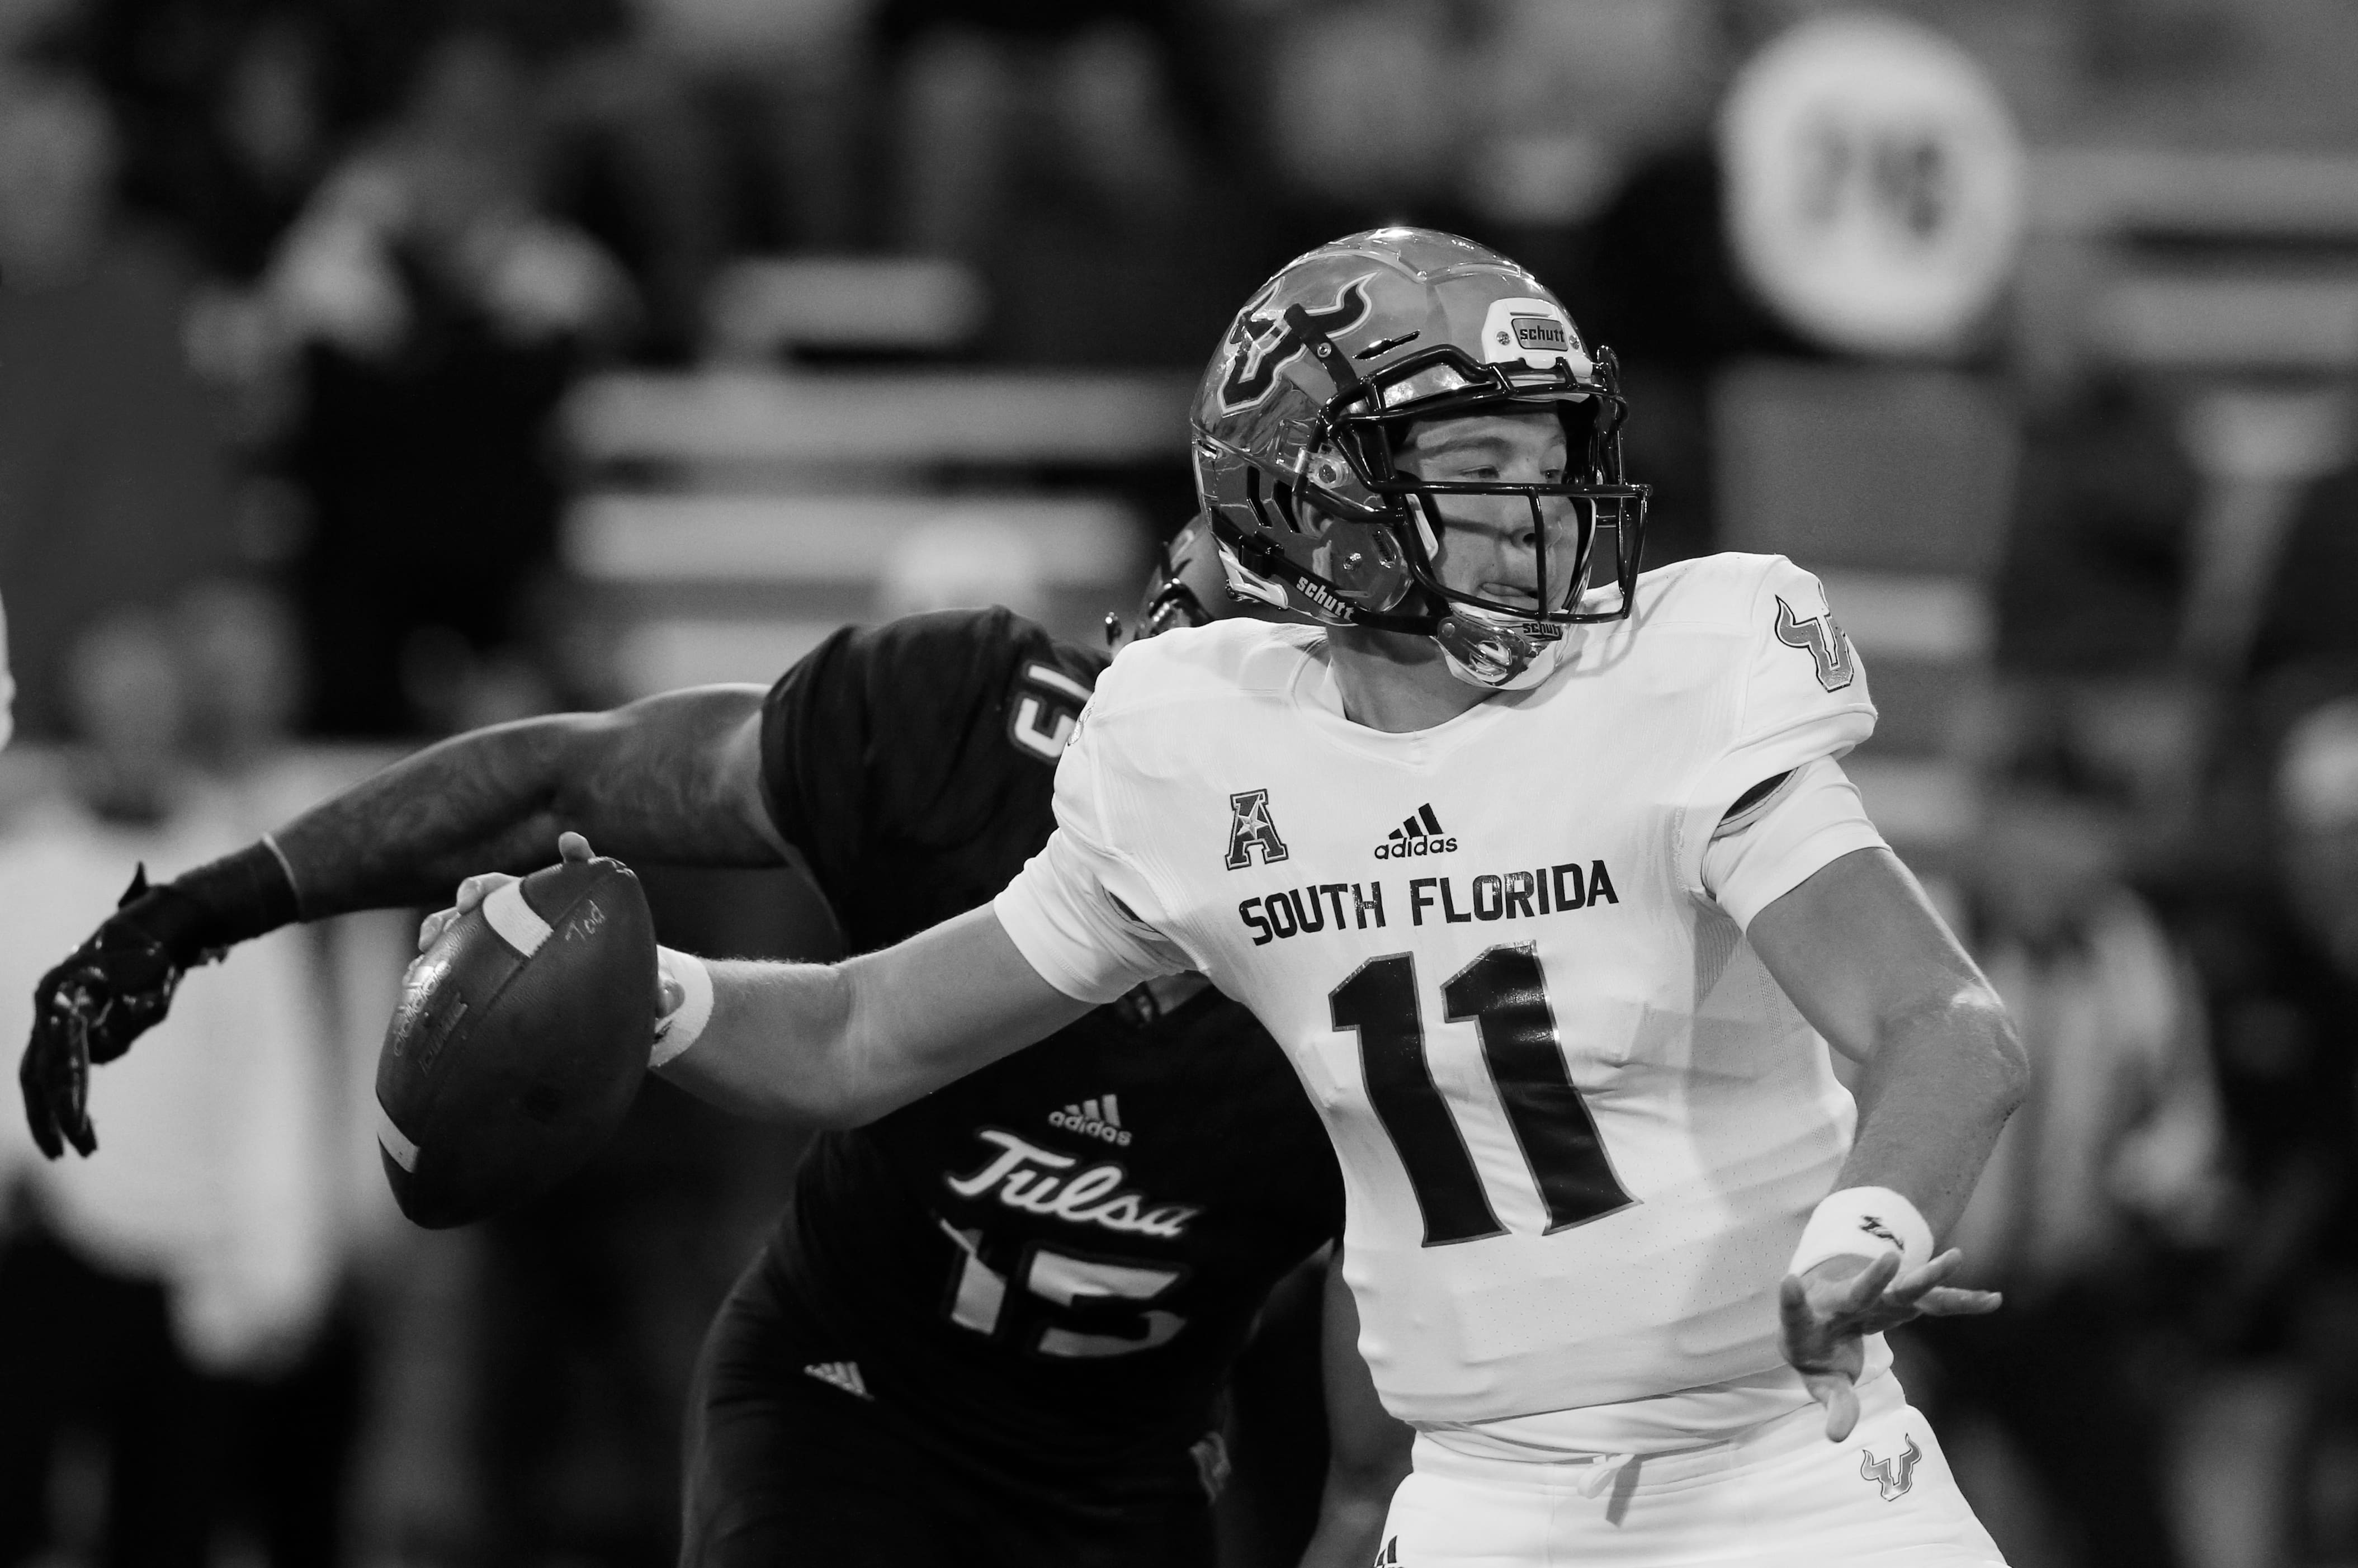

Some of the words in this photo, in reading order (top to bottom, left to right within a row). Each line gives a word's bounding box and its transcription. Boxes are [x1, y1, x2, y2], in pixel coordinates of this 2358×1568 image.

[1520, 325, 1565, 342] schutt
[1296, 576, 1354, 622] schutt
[1374, 838, 1458, 859] adidas
[1240, 882, 1387, 946] SOUTH
[1410, 860, 1619, 926] FLORIDA
[1329, 940, 1644, 1248] 11
[1048, 1110, 1132, 1146] adidas
[946, 1130, 1200, 1236] Tulsa
[938, 1217, 1190, 1358] 15
